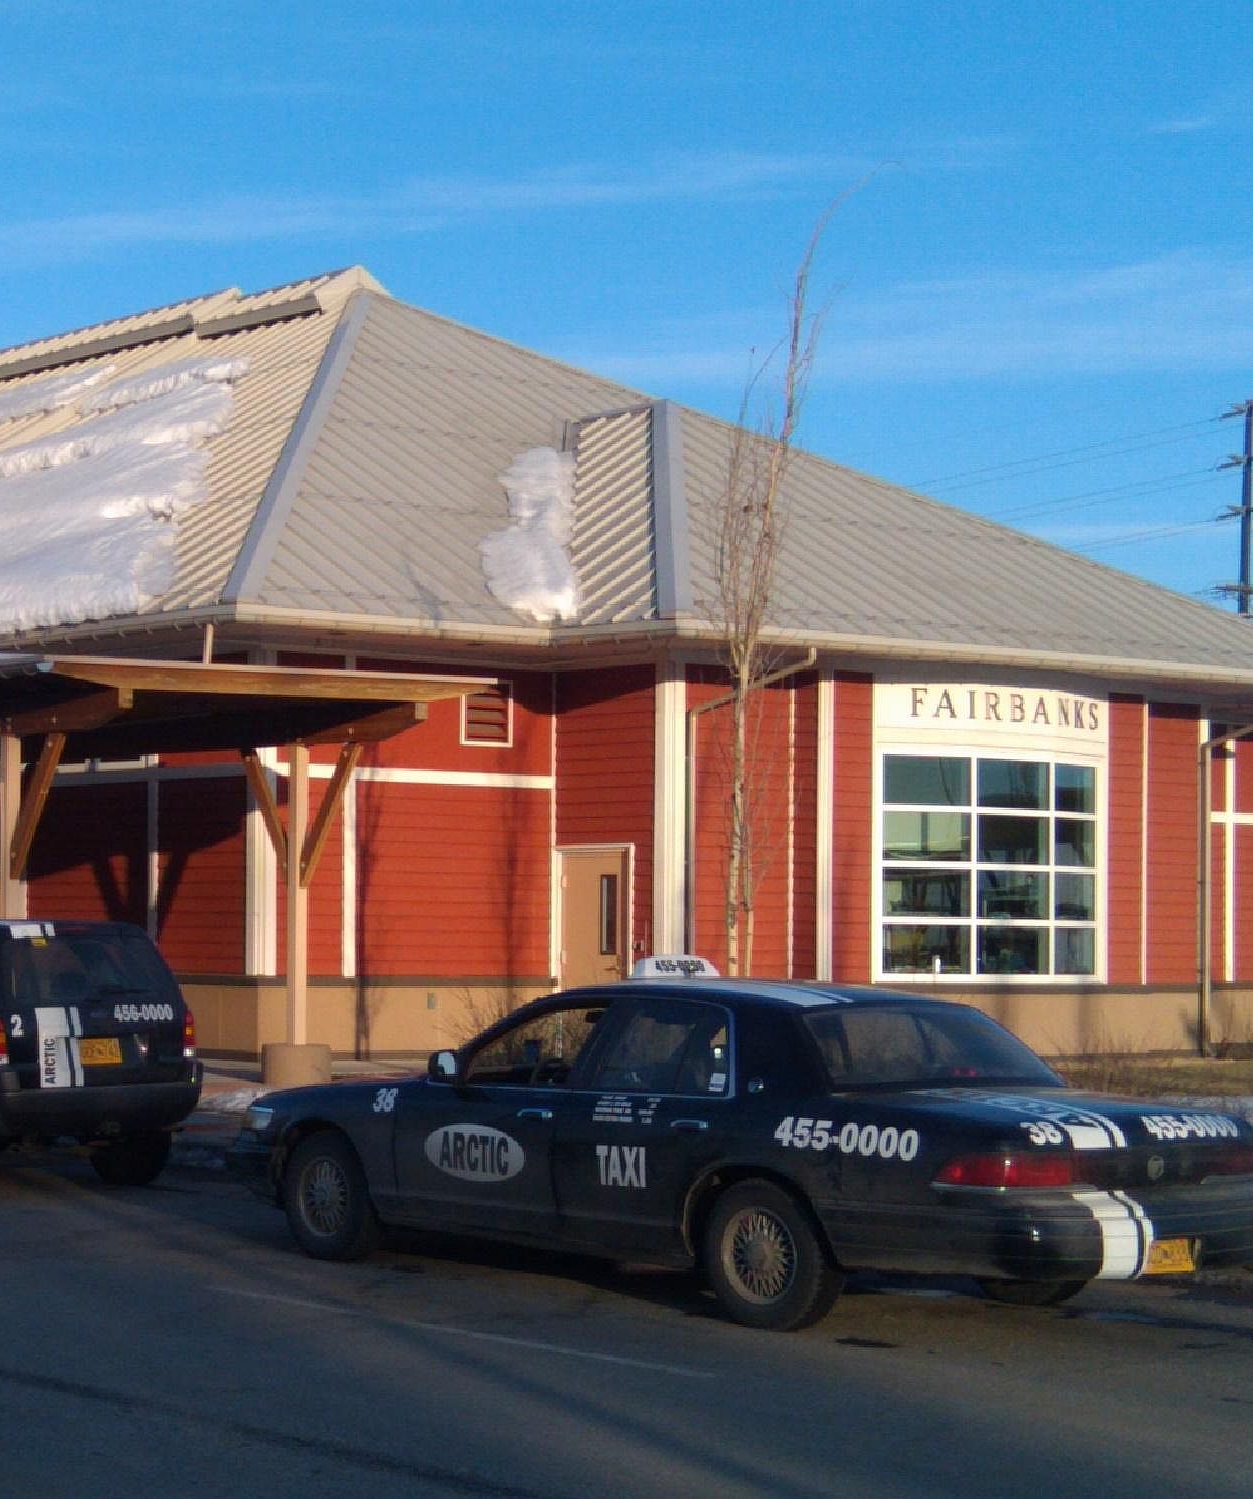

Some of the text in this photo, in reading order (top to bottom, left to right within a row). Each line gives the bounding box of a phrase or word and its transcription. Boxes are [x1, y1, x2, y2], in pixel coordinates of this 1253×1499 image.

[910, 687, 1099, 730] FAIRBANKS
[10, 1014, 24, 1037] 2
[44, 1037, 57, 1085] ARCTIC
[774, 1115, 919, 1162] 455-0000
[1019, 1121, 1063, 1146] 38
[1141, 1115, 1238, 1140] 455-0000
[440, 1131, 510, 1176] ARCTIC
[596, 1144, 647, 1188] TAXI
